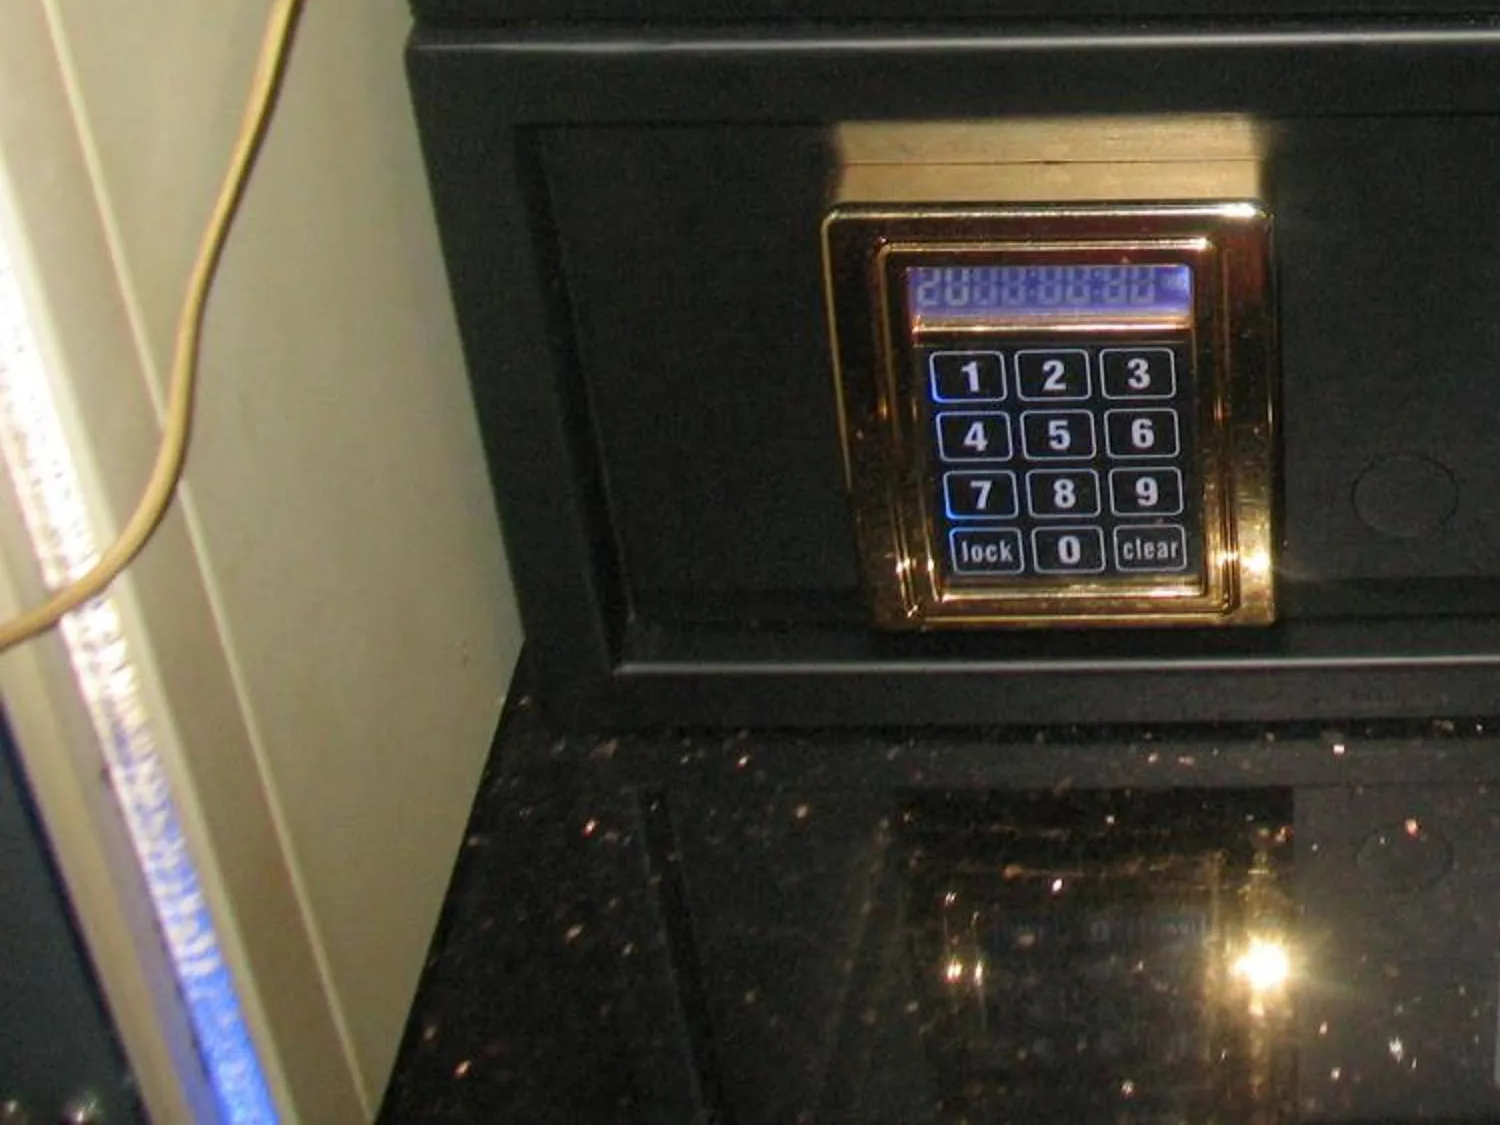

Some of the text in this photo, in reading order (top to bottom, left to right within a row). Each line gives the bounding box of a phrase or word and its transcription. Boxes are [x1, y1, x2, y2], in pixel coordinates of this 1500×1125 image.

[961, 358, 1151, 393] 1 2 3
[963, 418, 1155, 452] 4 5 6
[970, 477, 1159, 510] 7 8 9
[961, 535, 1179, 564] lock 0 clear
